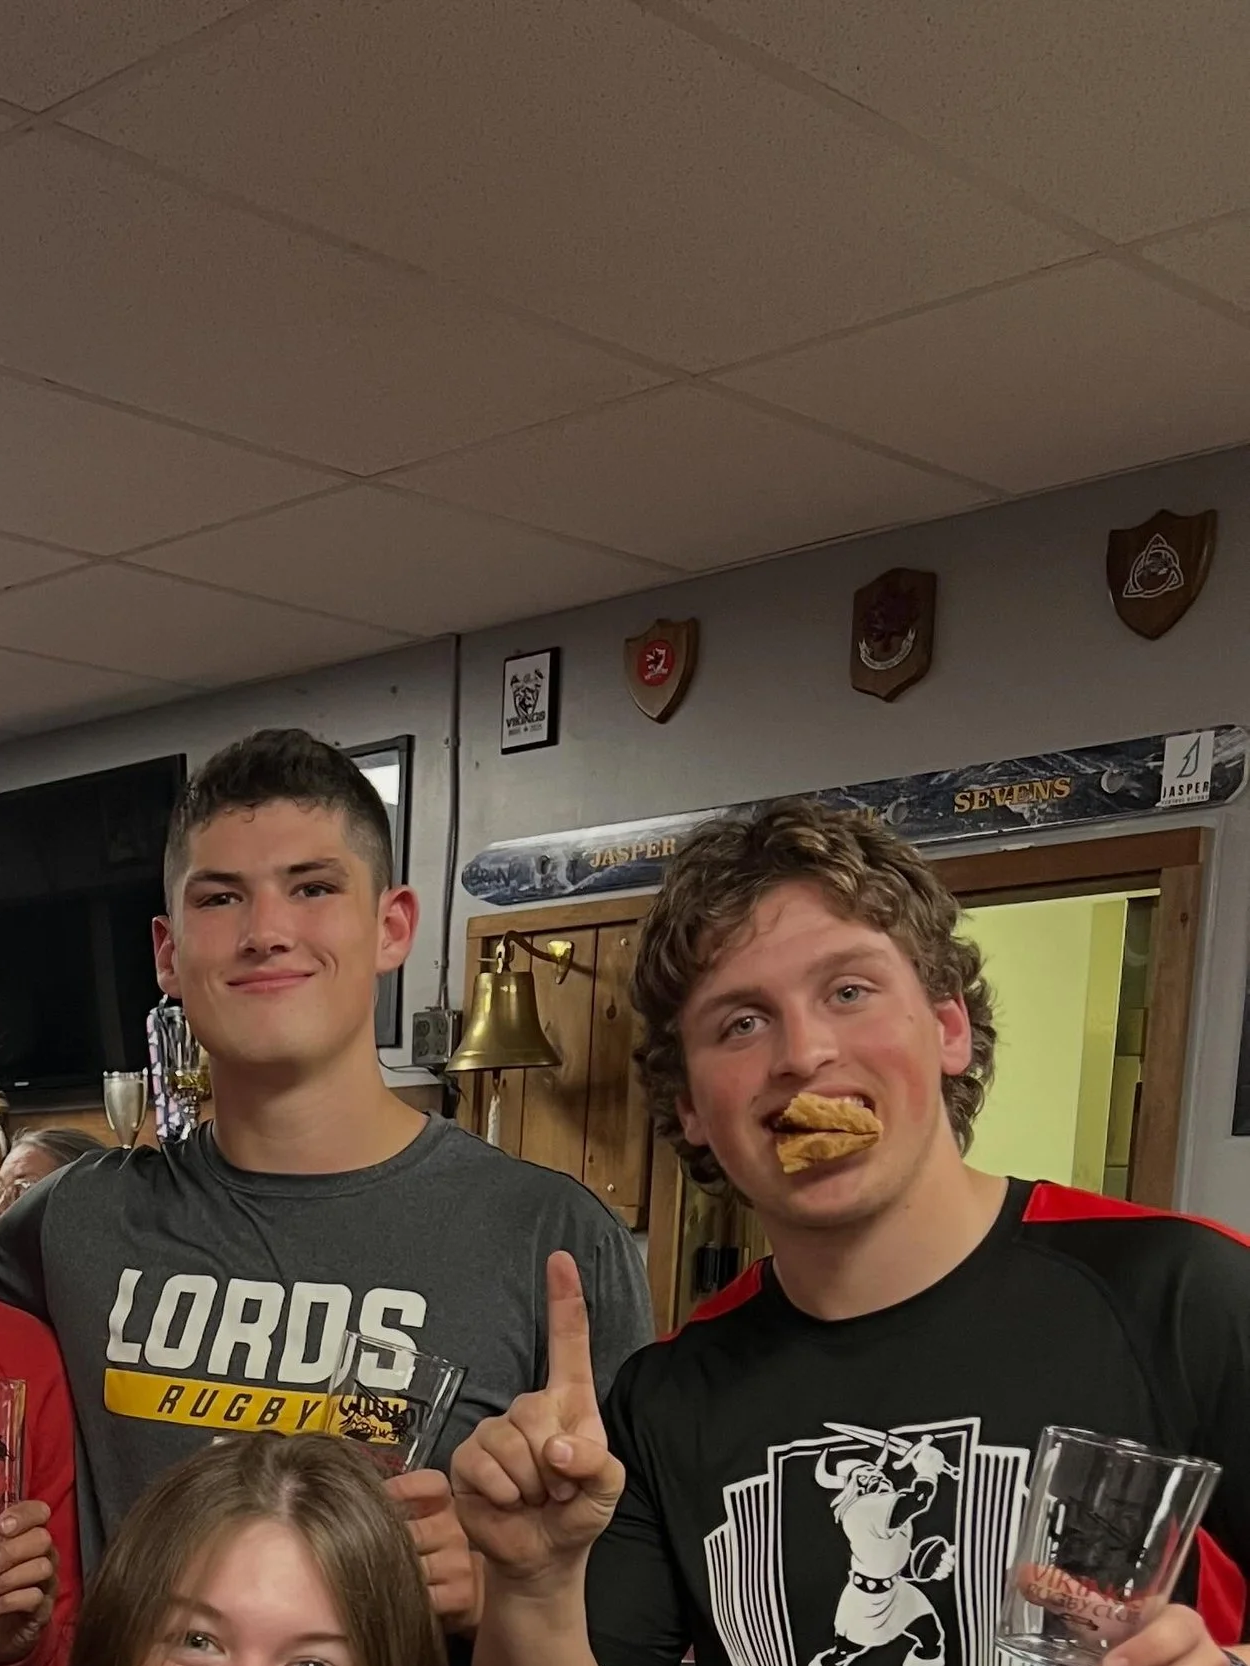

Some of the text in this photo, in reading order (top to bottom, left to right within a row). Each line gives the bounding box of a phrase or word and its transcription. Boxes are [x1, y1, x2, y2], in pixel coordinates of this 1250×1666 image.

[506, 711, 546, 728] VIKINGS
[1162, 781, 1210, 800] JASPER
[590, 777, 1072, 868] JASPER SEVENS
[105, 1268, 427, 1391] LORDS
[157, 1384, 323, 1430] RUGBY
